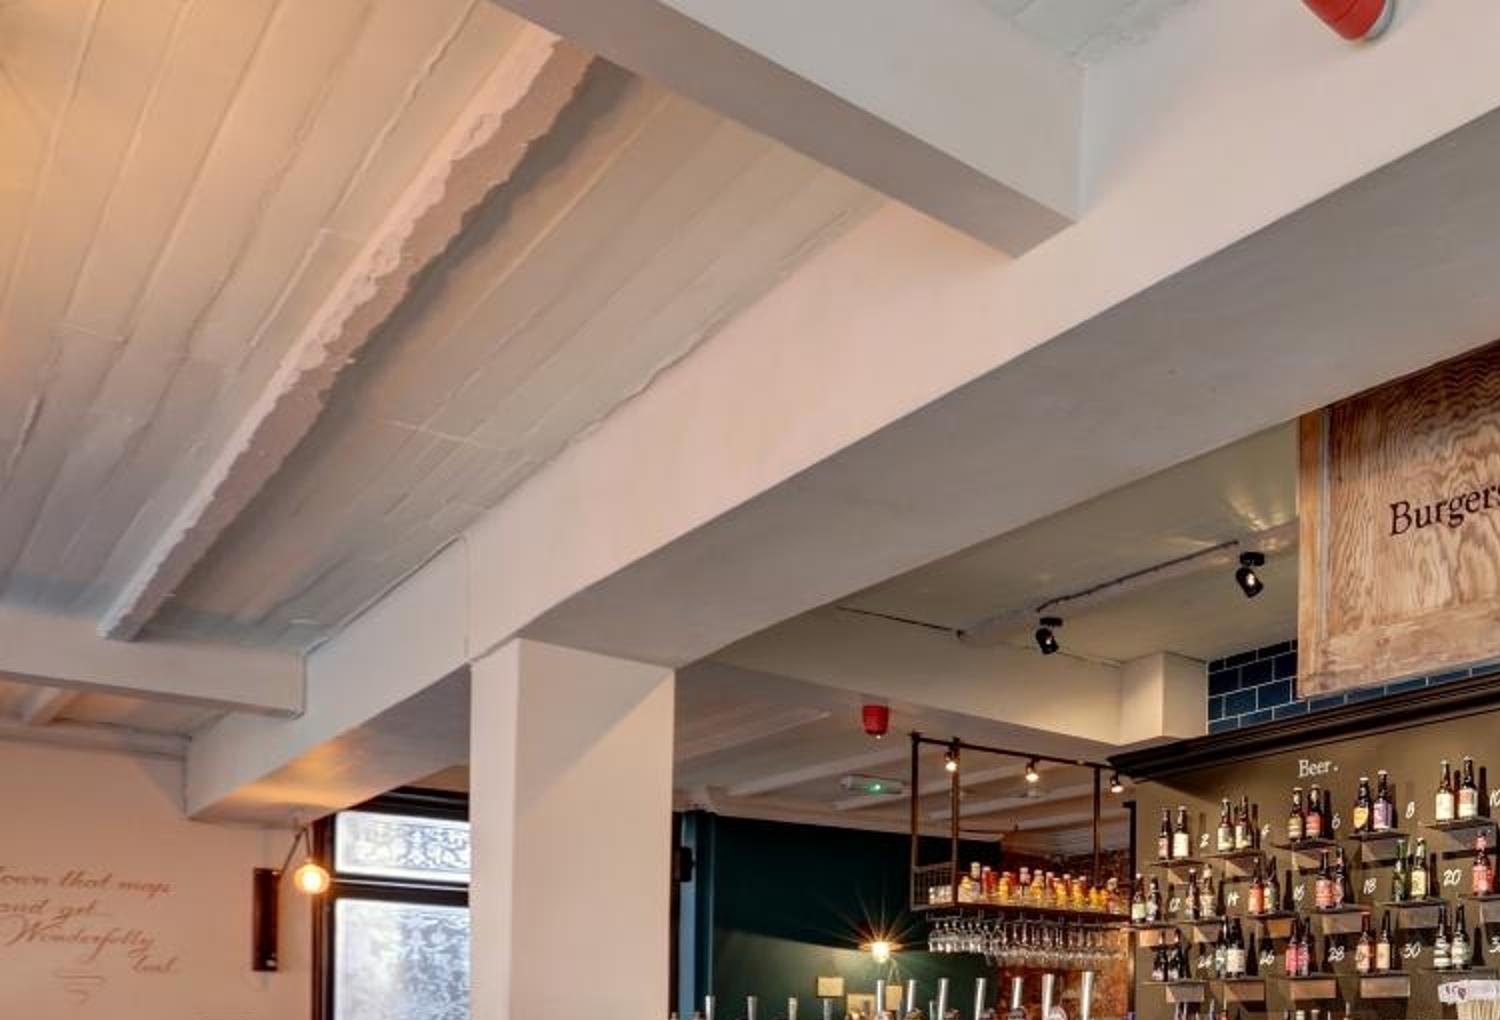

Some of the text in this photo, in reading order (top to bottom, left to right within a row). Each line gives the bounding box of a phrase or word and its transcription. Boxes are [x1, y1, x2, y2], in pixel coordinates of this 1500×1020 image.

[1199, 832, 1210, 849] 2
[1443, 868, 1462, 886] 20
[1363, 877, 1377, 896] 18
[1327, 945, 1345, 962] 28
[1402, 941, 1421, 959] 30
